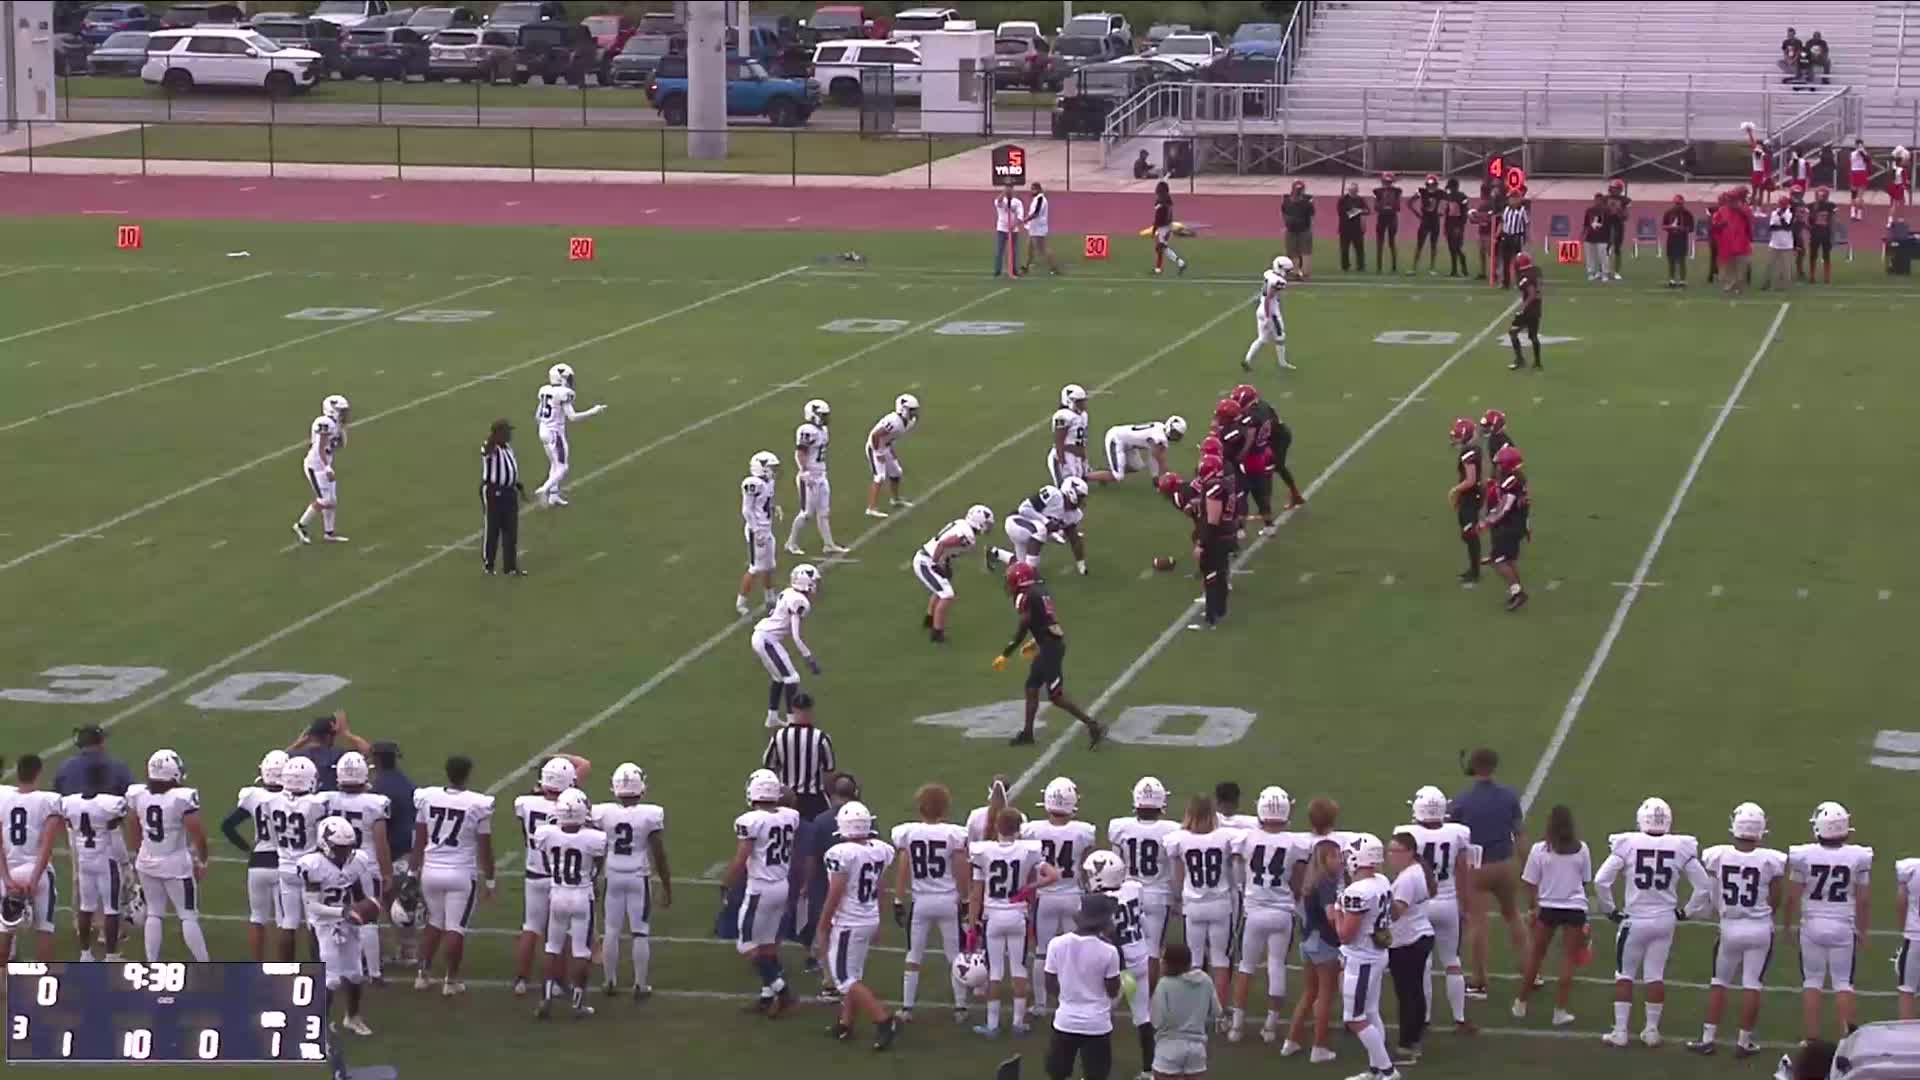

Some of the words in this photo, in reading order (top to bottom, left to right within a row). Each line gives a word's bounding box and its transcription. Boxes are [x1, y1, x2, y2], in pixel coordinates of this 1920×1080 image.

[995, 166, 1022, 175] YARD
[1009, 151, 1022, 166] 5
[1490, 157, 1502, 177] 4
[119, 228, 137, 246] 10
[572, 239, 589, 256] 20
[1088, 237, 1105, 254] 30
[1561, 243, 1578, 260] 40
[540, 393, 553, 419] 15
[10, 807, 27, 846] 8
[80, 812, 96, 848] 4
[146, 805, 165, 842] 9
[273, 810, 307, 850] 23
[429, 806, 466, 847] 77
[614, 823, 634, 855] 2
[766, 824, 793, 866] 26
[910, 840, 947, 879] 85
[1127, 838, 1160, 877] 18
[1423, 842, 1451, 881] 41
[551, 846, 583, 886] 10
[858, 861, 884, 903] 67
[989, 859, 1021, 899] 21
[1186, 847, 1223, 889] 88
[1250, 845, 1287, 887] 44
[1634, 849, 1676, 891] 55
[1810, 864, 1850, 902] 72
[1721, 865, 1760, 907] 53
